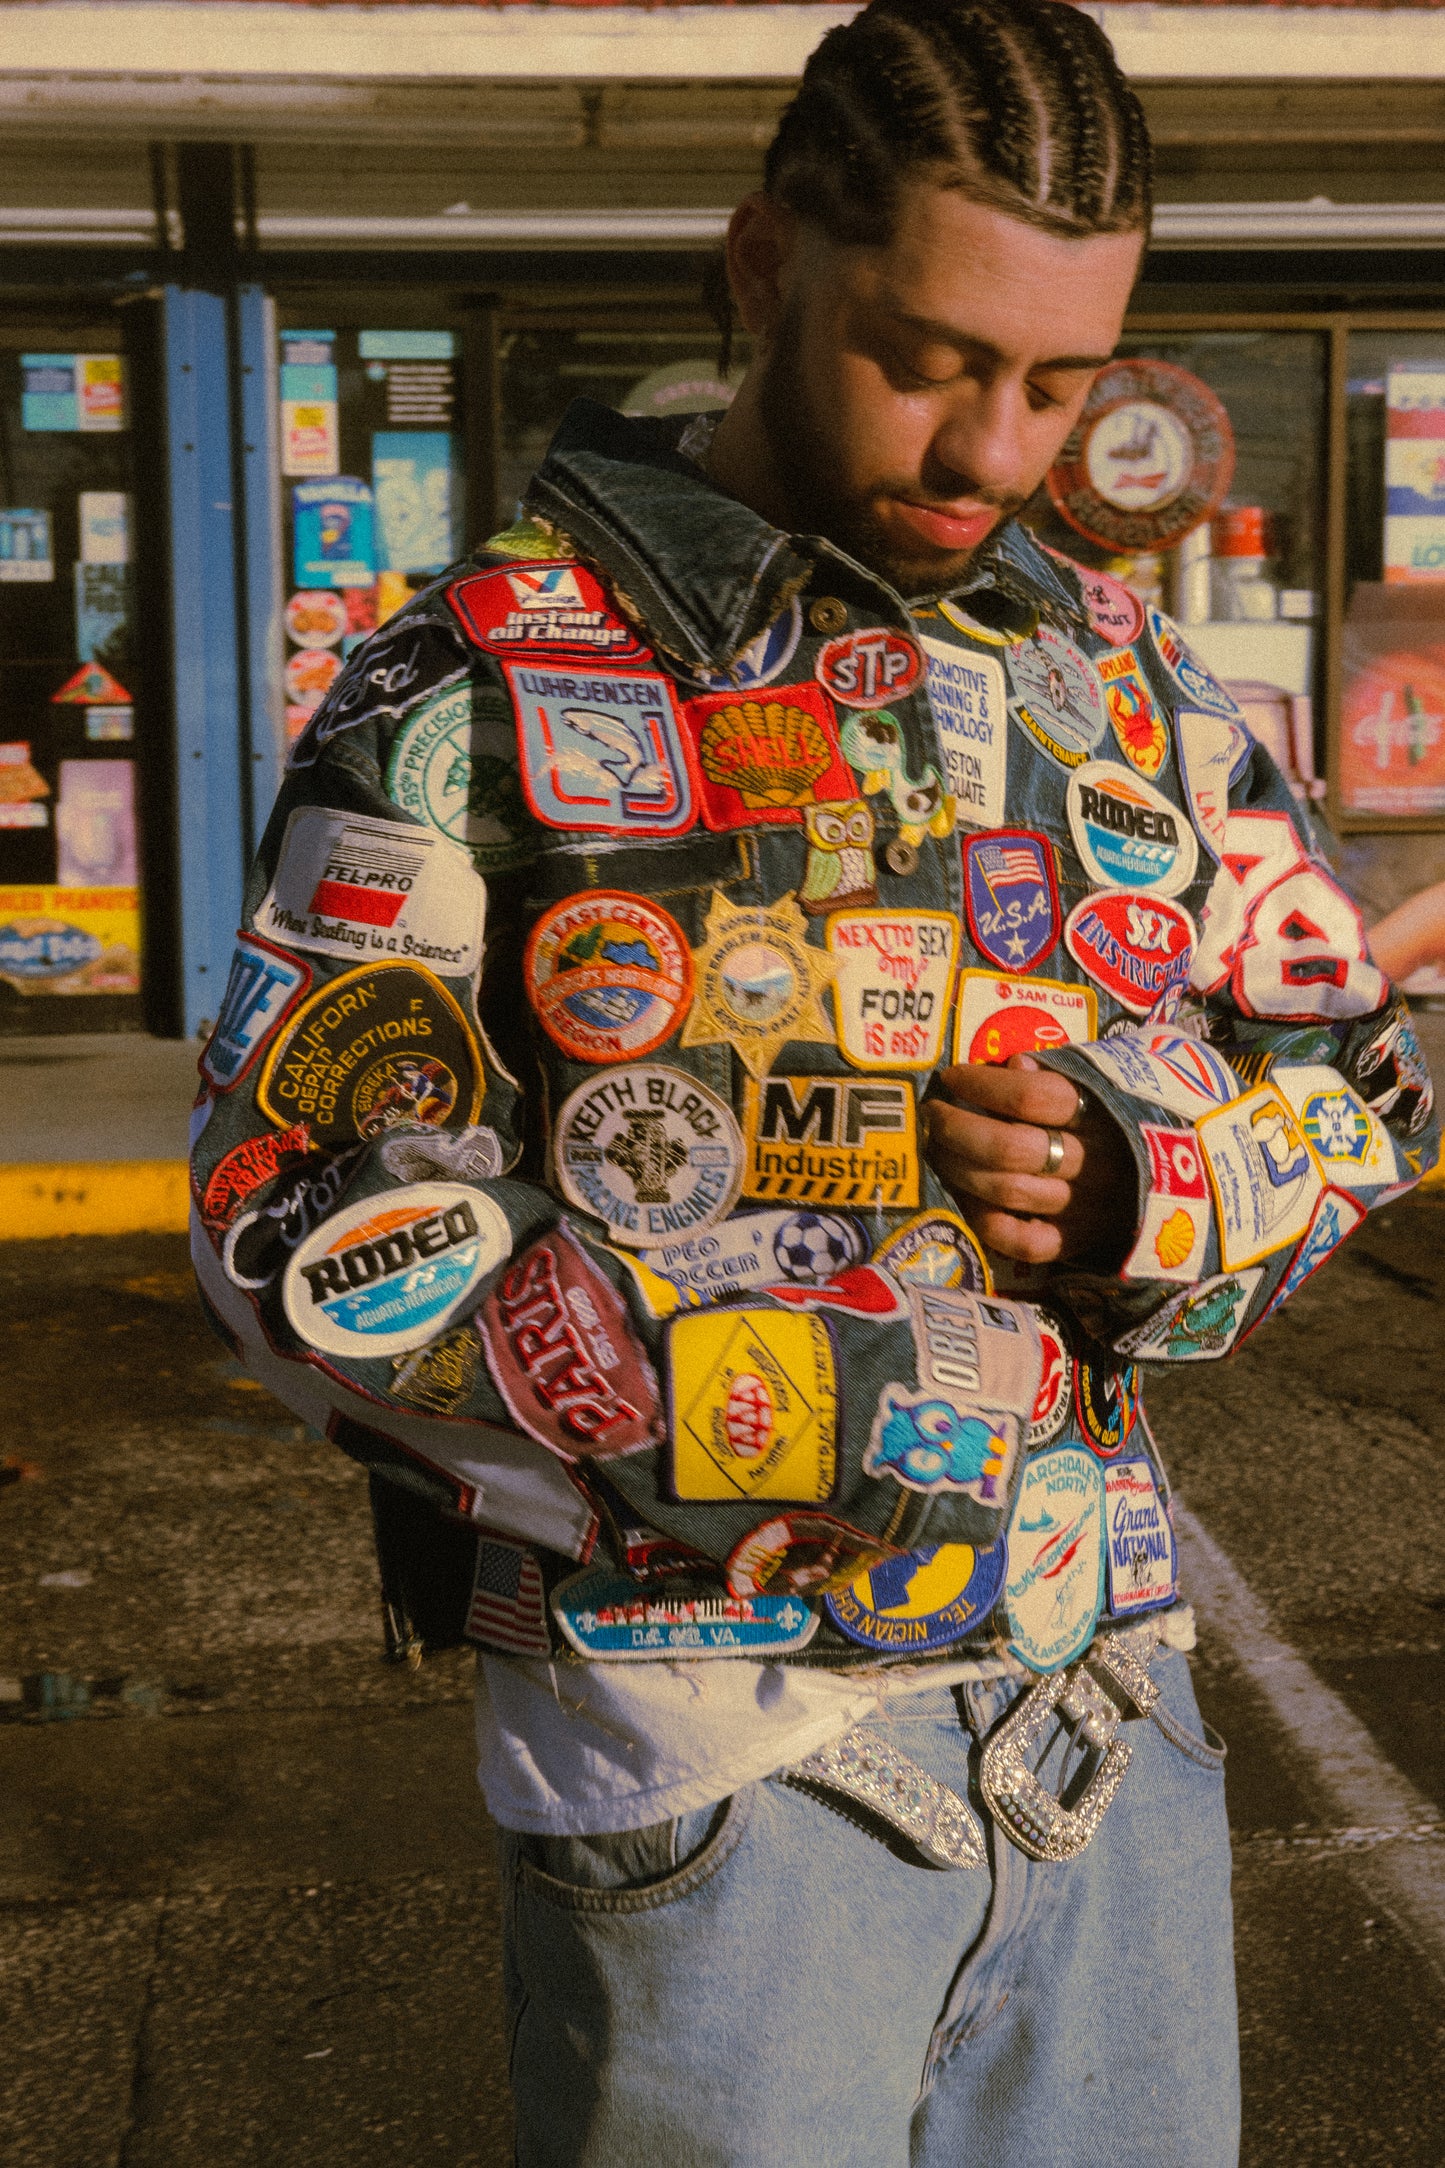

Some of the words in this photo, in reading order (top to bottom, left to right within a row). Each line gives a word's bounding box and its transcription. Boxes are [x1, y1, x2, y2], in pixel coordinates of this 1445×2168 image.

[506, 610, 605, 626] Instant
[528, 624, 627, 646] Change
[519, 673, 663, 707] LUHR-JENSEN
[832, 640, 909, 698] STP
[928, 656, 988, 696] OMOTIVE
[713, 733, 826, 774] SHELL
[1018, 708, 1088, 769] MAINTENANCE
[1078, 784, 1180, 847] RODEO
[322, 865, 413, 892] FEL-PRO
[978, 890, 1051, 937] U.S.A.
[1126, 903, 1177, 954] SEX
[371, 933, 386, 950] is
[387, 937, 397, 951] a
[918, 925, 950, 959] SEX
[861, 988, 935, 1021] FORD
[1016, 988, 1047, 1004] SAM
[1052, 993, 1084, 1009] CLUB
[277, 981, 378, 1099] CALIFORN
[316, 1016, 433, 1126] CORRECTIONS
[358, 1062, 399, 1113] EUREKA
[568, 1077, 637, 1144] KEITH
[646, 1077, 723, 1139] BLACK
[757, 1078, 906, 1147] MF
[754, 1146, 907, 1180] Industrial
[649, 1167, 728, 1234] ENGINES
[300, 1200, 480, 1305] RODEO
[669, 1251, 760, 1285] OCCER
[501, 1247, 646, 1442] PARIS
[921, 1295, 982, 1393] OBEY
[1046, 1476, 1087, 1498] NORTH
[1113, 1495, 1160, 1541] Grand
[1112, 1532, 1168, 1569] NATIONAL
[711, 1625, 741, 1646] VA.
